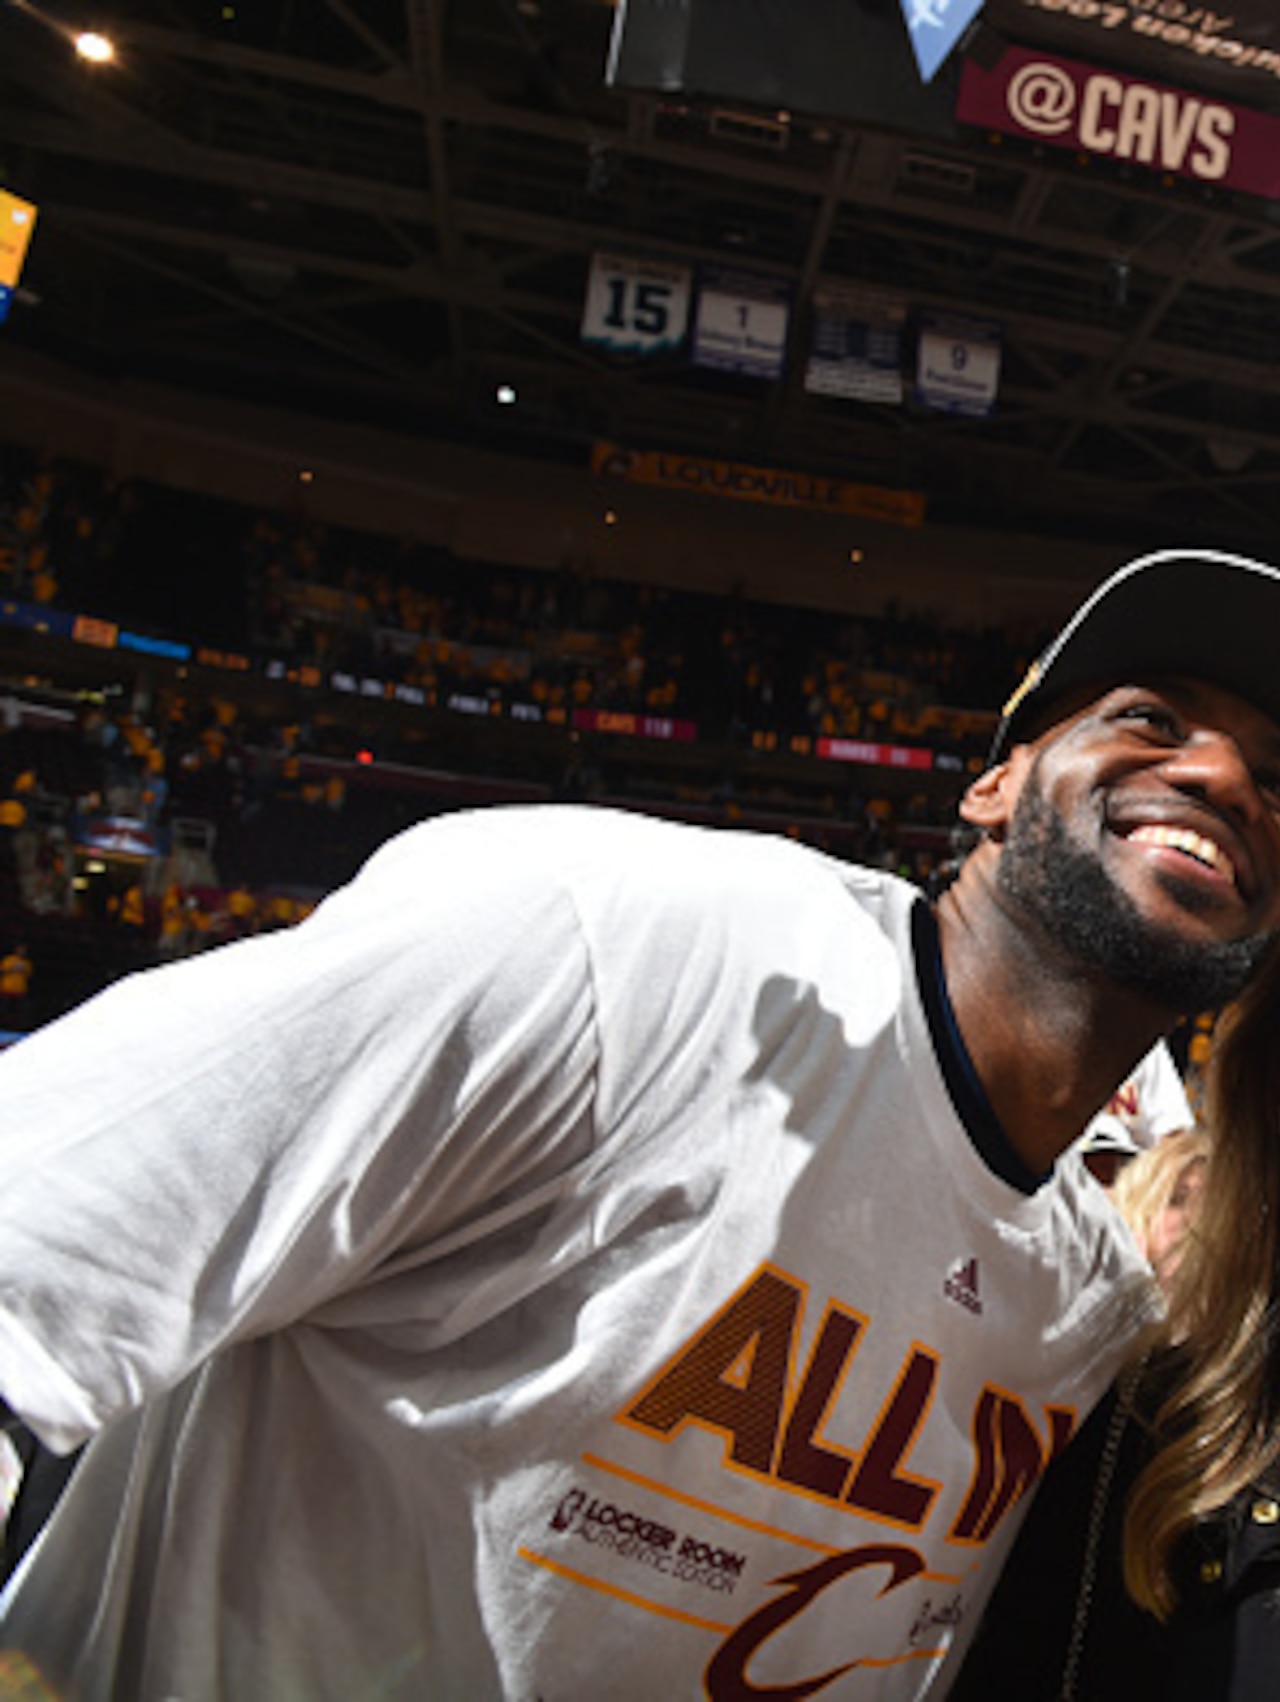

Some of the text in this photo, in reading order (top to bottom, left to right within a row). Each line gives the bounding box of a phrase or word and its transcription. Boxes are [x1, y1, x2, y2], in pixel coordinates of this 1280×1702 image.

[1006, 61, 1236, 181] @CAVS
[603, 277, 672, 336] 15
[612, 1260, 944, 1533] ALL
[585, 1499, 746, 1577] LOCKER ROOM
